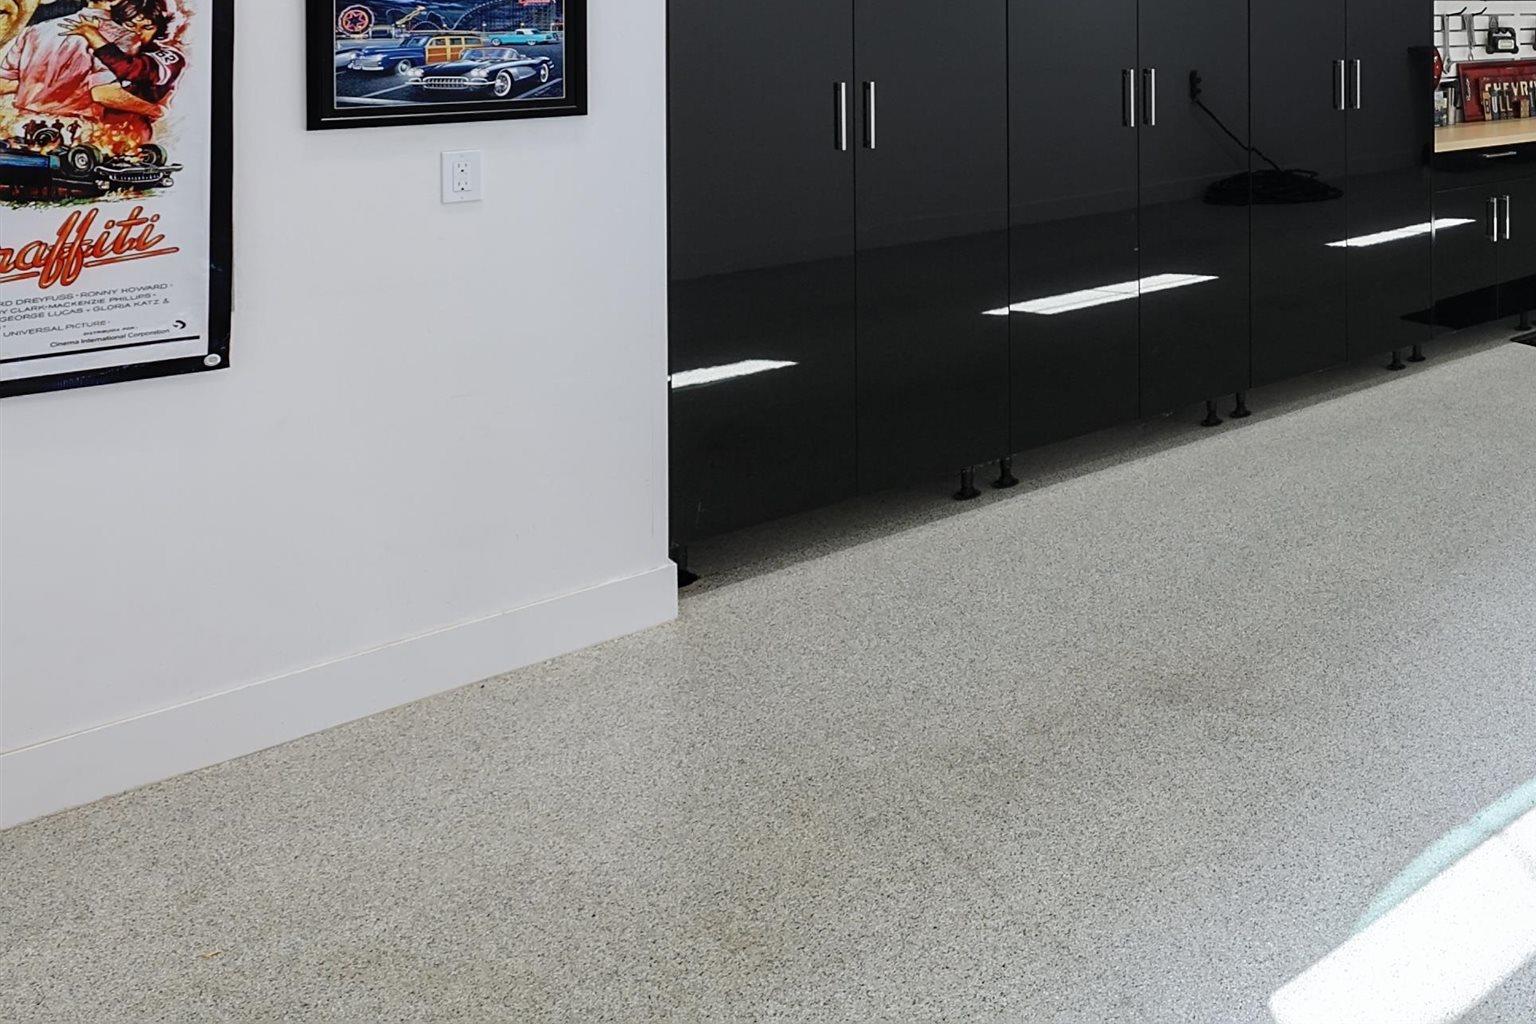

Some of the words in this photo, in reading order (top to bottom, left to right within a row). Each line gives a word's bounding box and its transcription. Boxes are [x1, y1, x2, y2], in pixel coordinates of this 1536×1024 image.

[16, 293, 74, 306] DREYFUSS
[80, 288, 118, 297] RONNY
[121, 283, 168, 293] HOWARD
[0, 312, 44, 322] GEORGE
[48, 307, 83, 317] LUCAS
[93, 303, 131, 312] GLORIA
[133, 299, 160, 307] KATZ
[3, 326, 64, 337] UNIVERSAL
